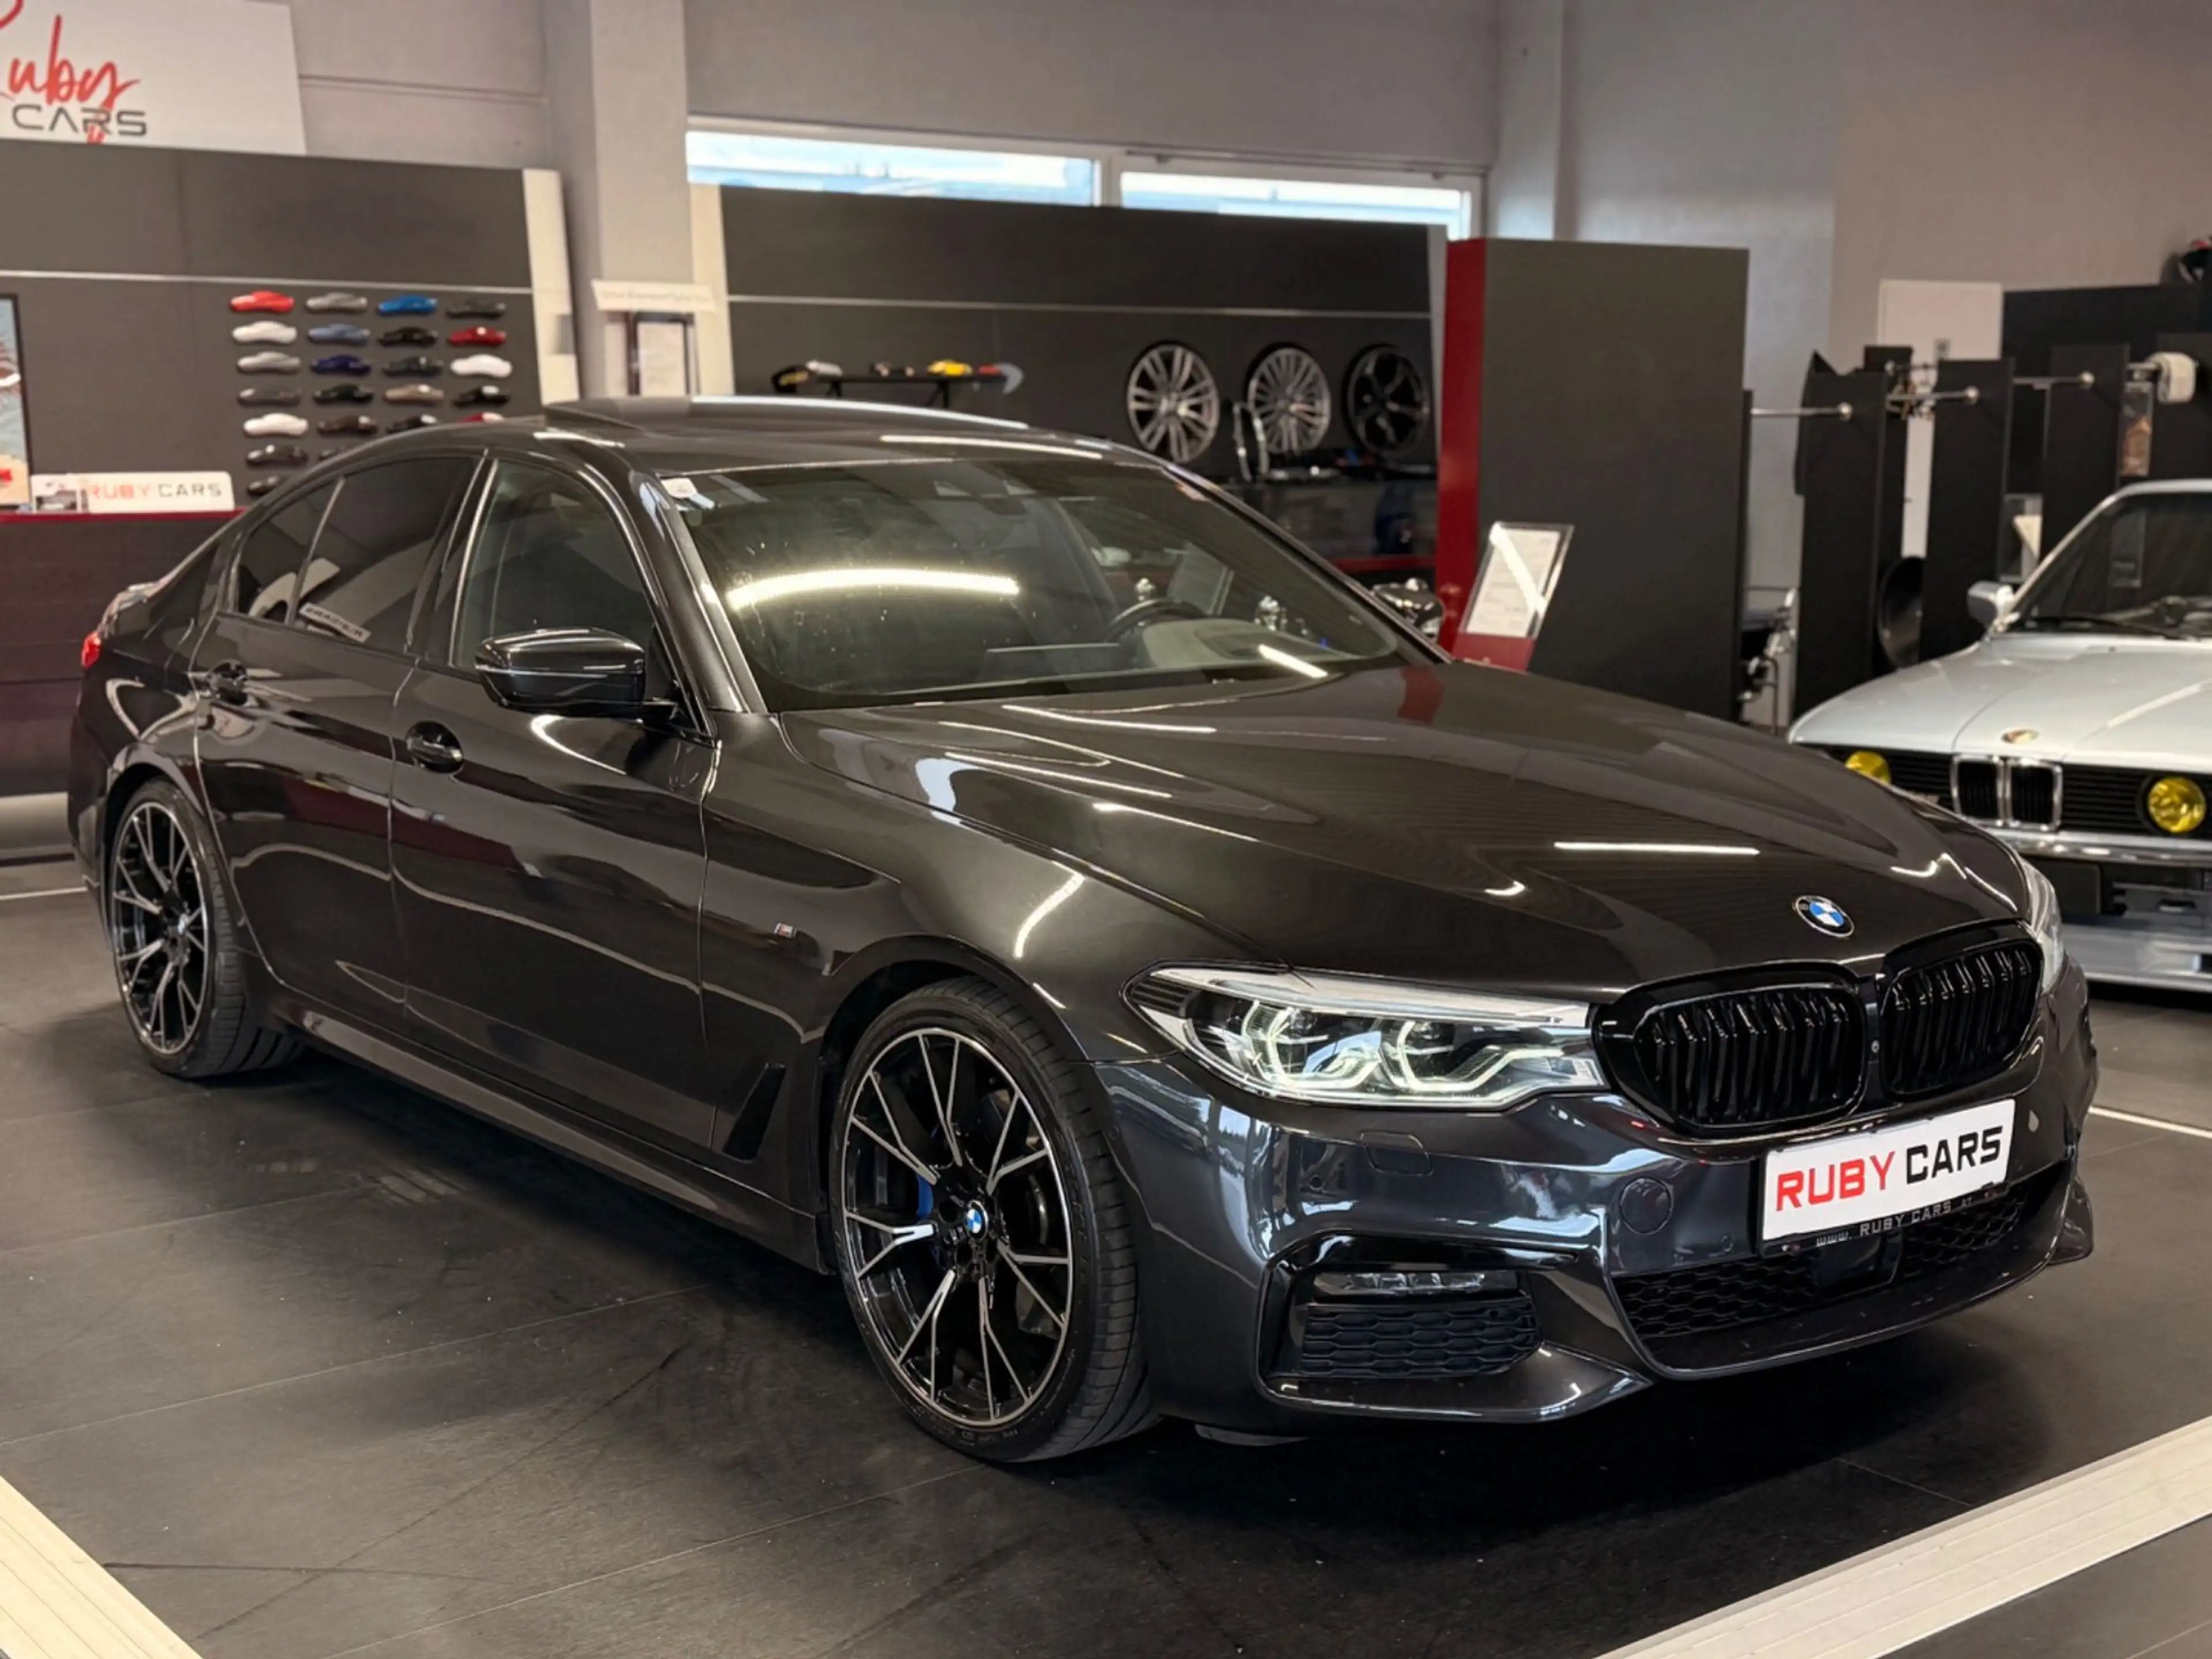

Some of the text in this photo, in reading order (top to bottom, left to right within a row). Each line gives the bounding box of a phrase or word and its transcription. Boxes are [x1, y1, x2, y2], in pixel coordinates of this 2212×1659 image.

[0, 0, 141, 144] uby
[12, 104, 147, 137] CARS
[87, 482, 222, 499] RUBY CARS
[1775, 1126, 2003, 1211] RUBY CARS
[1859, 1214, 1904, 1237] RUBY
[1911, 1199, 1952, 1224] CARS
